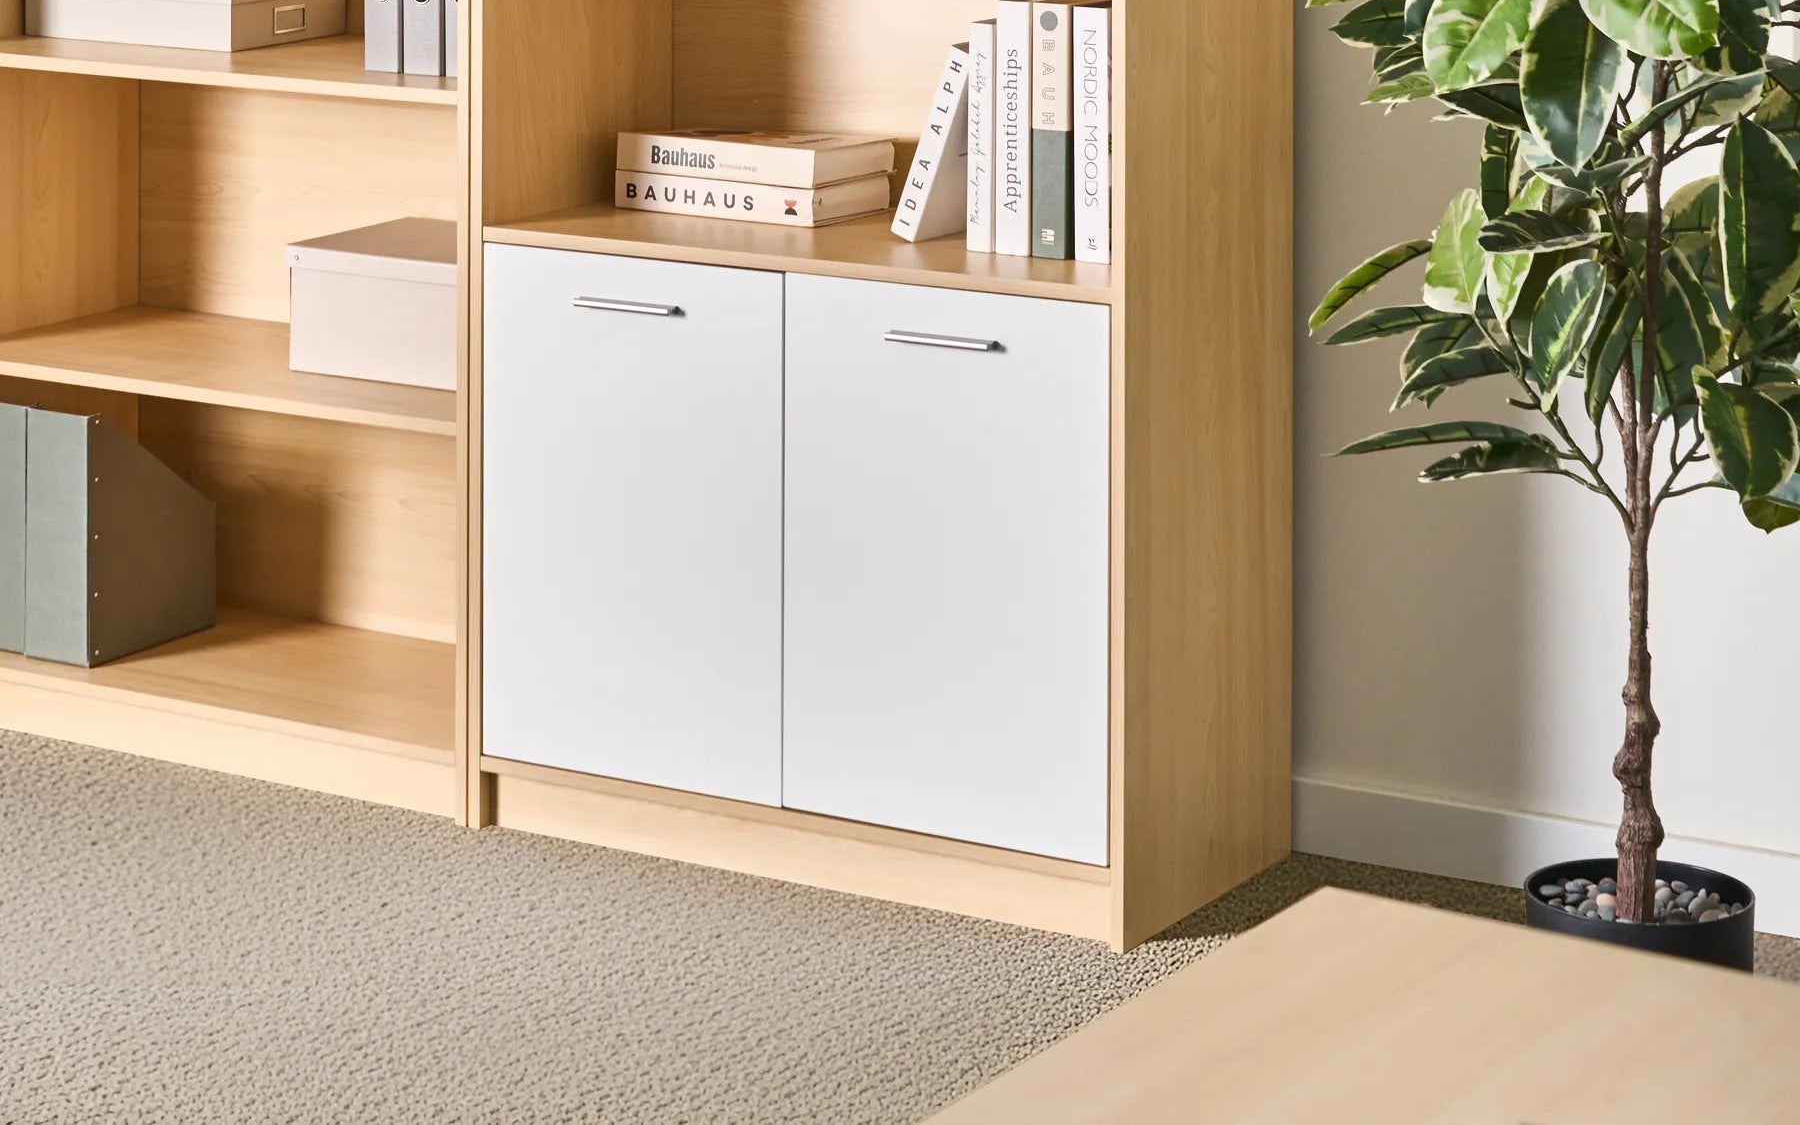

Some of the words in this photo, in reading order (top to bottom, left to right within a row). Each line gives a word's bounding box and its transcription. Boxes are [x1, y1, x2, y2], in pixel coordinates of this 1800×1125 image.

[1083, 29, 1098, 116] NORDIC
[651, 145, 716, 170] Bauhaus
[1003, 48, 1022, 213] Apprenticeships
[1084, 125, 1099, 208] MOODS
[626, 183, 754, 211] BAUHAUS
[899, 158, 931, 227] IDEA
